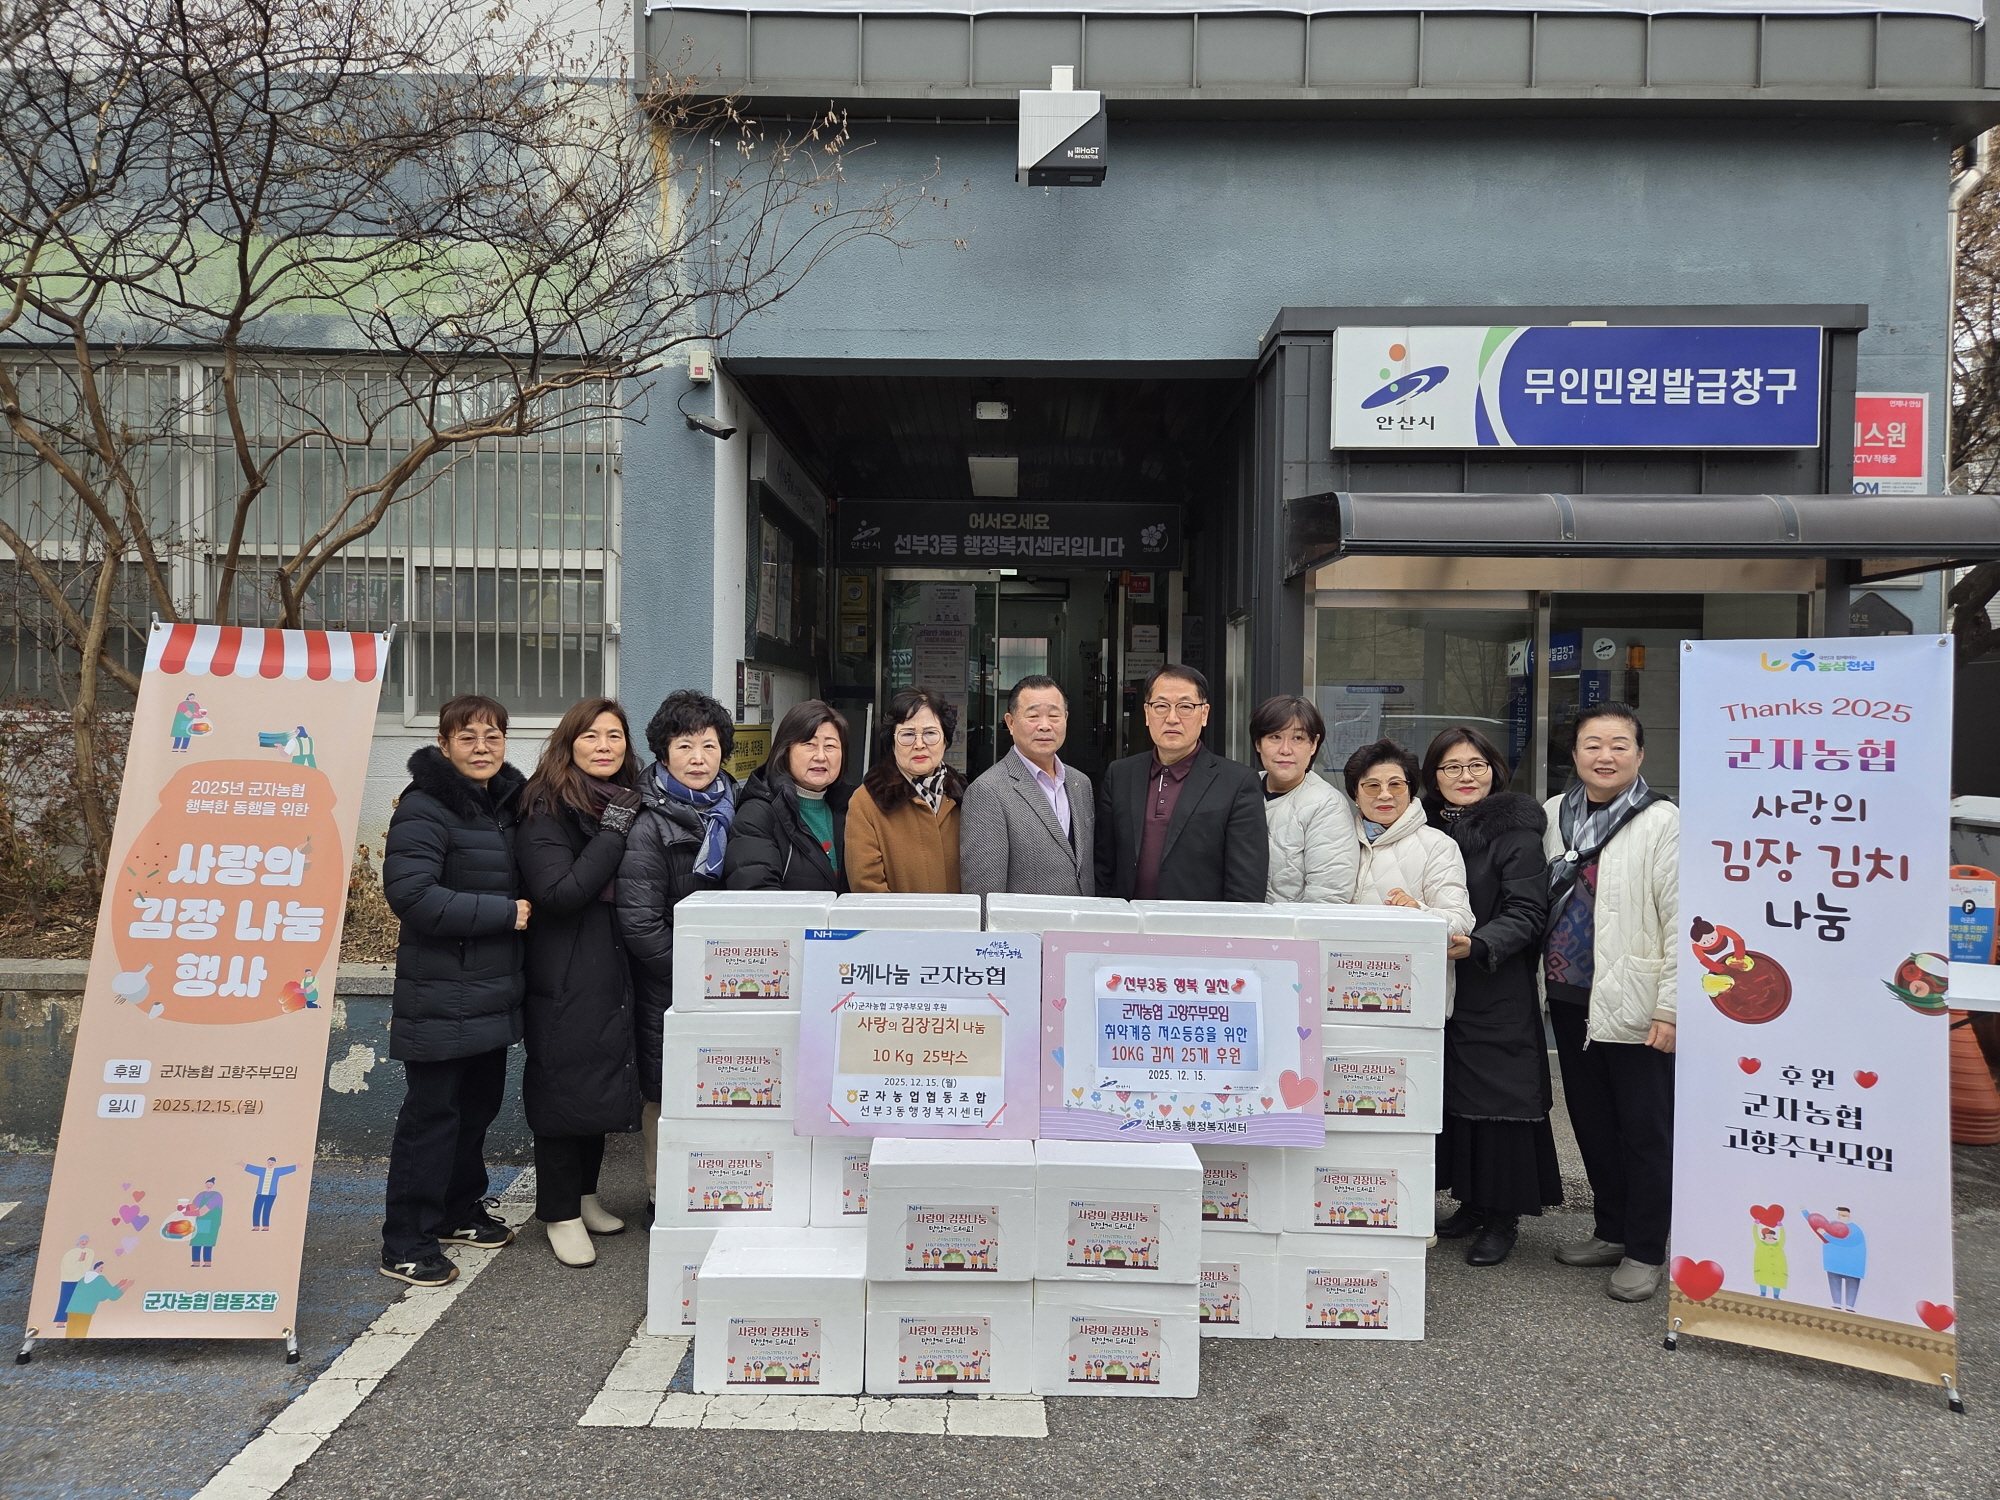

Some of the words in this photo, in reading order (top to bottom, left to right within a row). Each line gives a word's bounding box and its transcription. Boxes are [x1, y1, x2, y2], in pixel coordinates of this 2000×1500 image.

[1524, 367, 1798, 407] 무인민원발급창구
[1376, 416, 1434, 430] 안산시
[1854, 455, 1872, 463] CTV
[1874, 455, 1896, 463] 작동중
[969, 513, 1049, 530] 어서오세요
[851, 541, 880, 549] 안산시
[894, 534, 957, 555] 선부3동
[964, 535, 1124, 557] 행정복지센터입니다
[1818, 661, 1874, 671] 농심천심
[1720, 699, 1823, 722] Thanks
[1832, 698, 1913, 723] 2025
[1725, 738, 1895, 772] 군자농협
[190, 780, 244, 797] 2025년
[248, 781, 305, 798] 군자농협
[185, 799, 229, 815] 행복한
[232, 801, 276, 817] 동행을
[281, 802, 309, 817] 위한
[1752, 790, 1866, 825] 사랑의
[168, 843, 304, 887] 사랑의
[1712, 839, 1801, 882] 김장
[1818, 845, 1908, 888] 김치
[129, 898, 225, 940] 김장
[235, 900, 324, 941] 나눔
[1766, 893, 1850, 941] 나눔
[714, 948, 740, 956] 사랑의
[1337, 960, 1362, 969] 사랑의
[172, 953, 267, 998] 행사
[920, 966, 1006, 985] 군자농협
[1124, 976, 1167, 993] 선부3동
[1174, 978, 1198, 993] 행복
[1205, 979, 1230, 994] 실천
[889, 1002, 931, 1011] 고향주부모임
[933, 1003, 947, 1012] 후원
[1123, 1004, 1162, 1021] 군자농협
[1168, 1005, 1229, 1022] 고향주부모임
[858, 1017, 897, 1033] 사랑의
[901, 1017, 959, 1034] 김장김치
[963, 1022, 986, 1034] 나눔
[1105, 1024, 1151, 1042] 취약계층
[1224, 1027, 1247, 1043] 위한
[706, 1056, 732, 1064] 사랑의
[873, 1049, 889, 1061] 10
[896, 1050, 913, 1065] Kg
[923, 1050, 968, 1065] 25박스
[1112, 1046, 1143, 1062] 10KG
[1151, 1047, 1175, 1063] 김치
[1182, 1047, 1209, 1063] 25개
[1217, 1048, 1241, 1065] 후원
[114, 1065, 140, 1078] 후원
[160, 1064, 213, 1079] 군자농협
[218, 1065, 298, 1080] 고향주부모임
[1149, 1070, 1172, 1080] 2025.
[1177, 1070, 1189, 1081] 12.
[1195, 1071, 1206, 1082] 15.
[1333, 1064, 1358, 1072] 사랑의
[942, 1079, 957, 1089] (월)
[108, 1099, 136, 1114] 일시
[1742, 1092, 1862, 1130] 군자농협
[1146, 1120, 1181, 1131] 선부3동
[1187, 1121, 1247, 1133] 행정복지센터
[1723, 1125, 1893, 1172] 고향주부모임
[697, 1160, 723, 1168] 사랑의
[1323, 1175, 1348, 1184] 사랑의
[916, 1214, 944, 1223] 사랑의
[1078, 1210, 1106, 1219] 사랑의
[1315, 1278, 1340, 1286] 사랑의
[144, 1293, 210, 1311] 군자농협
[214, 1293, 277, 1311] 협동조합
[738, 1327, 766, 1336] 사랑의
[908, 1326, 936, 1335] 사랑의
[1079, 1325, 1107, 1334] 사랑의
